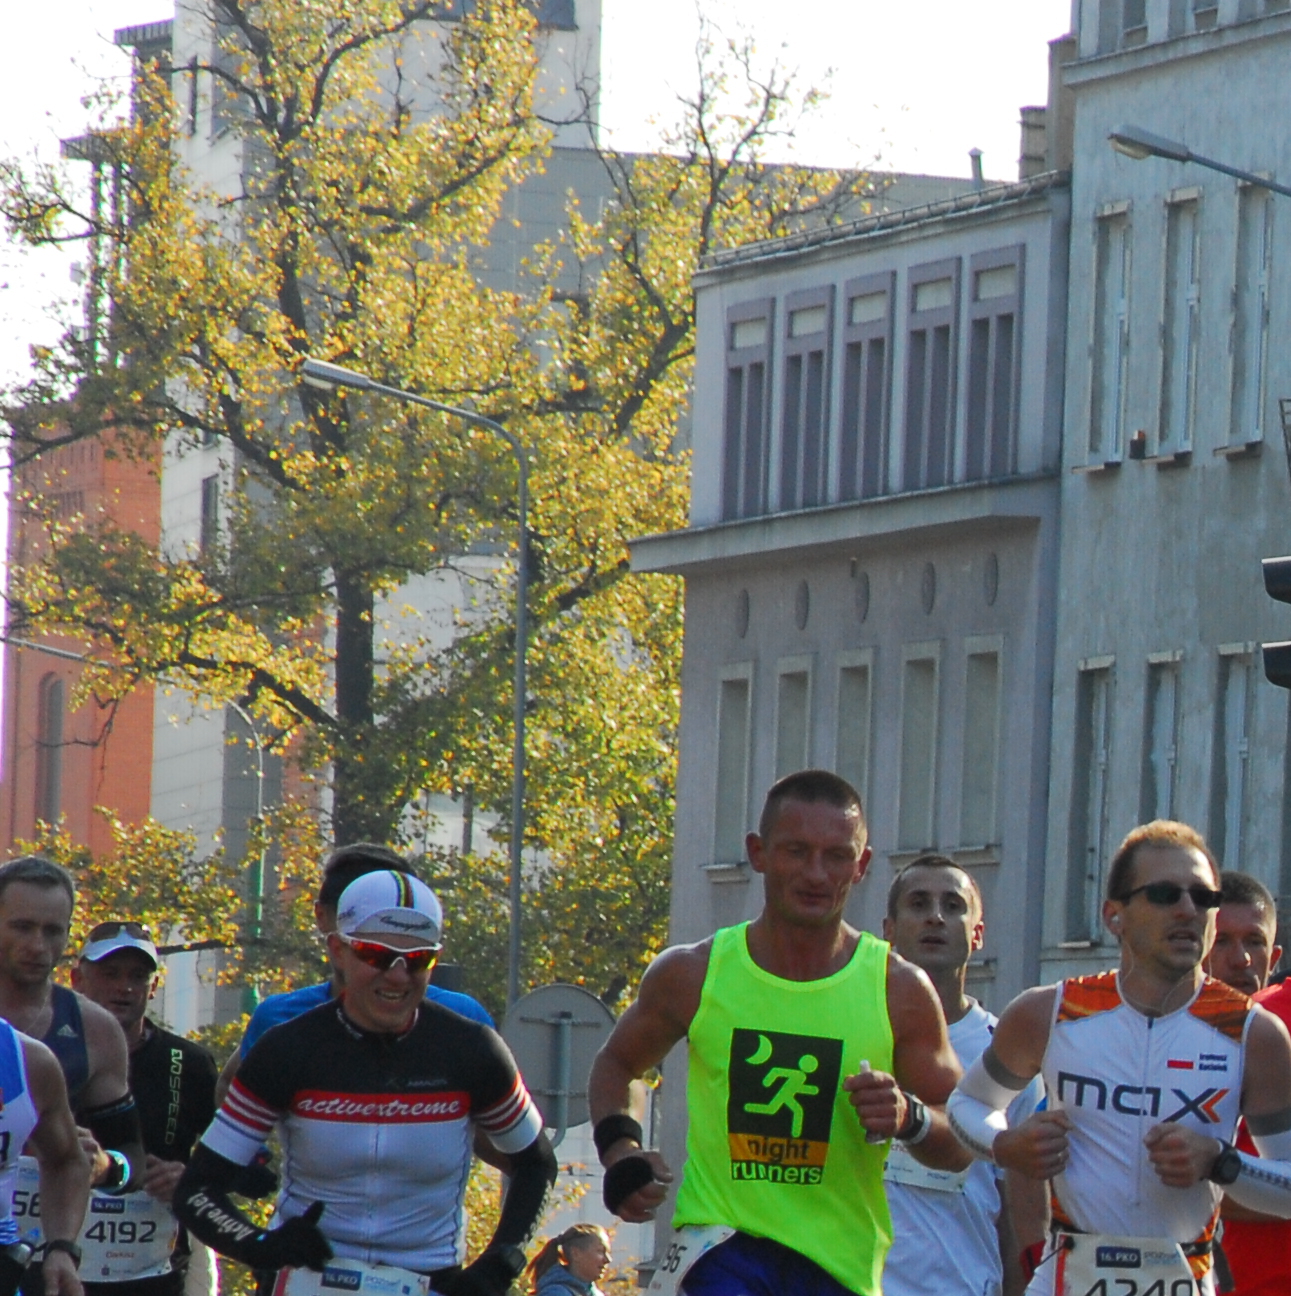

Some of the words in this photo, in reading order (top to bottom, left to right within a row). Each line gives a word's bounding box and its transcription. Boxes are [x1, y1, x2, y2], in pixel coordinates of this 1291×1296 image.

[297, 1097, 461, 1118] activextreme
[748, 1137, 808, 1166] night
[732, 1161, 821, 1184] runners
[85, 1220, 157, 1244] 4192
[1100, 1252, 1114, 1262] 16.
[1116, 1253, 1138, 1263] PKO
[338, 1274, 358, 1286] PKO
